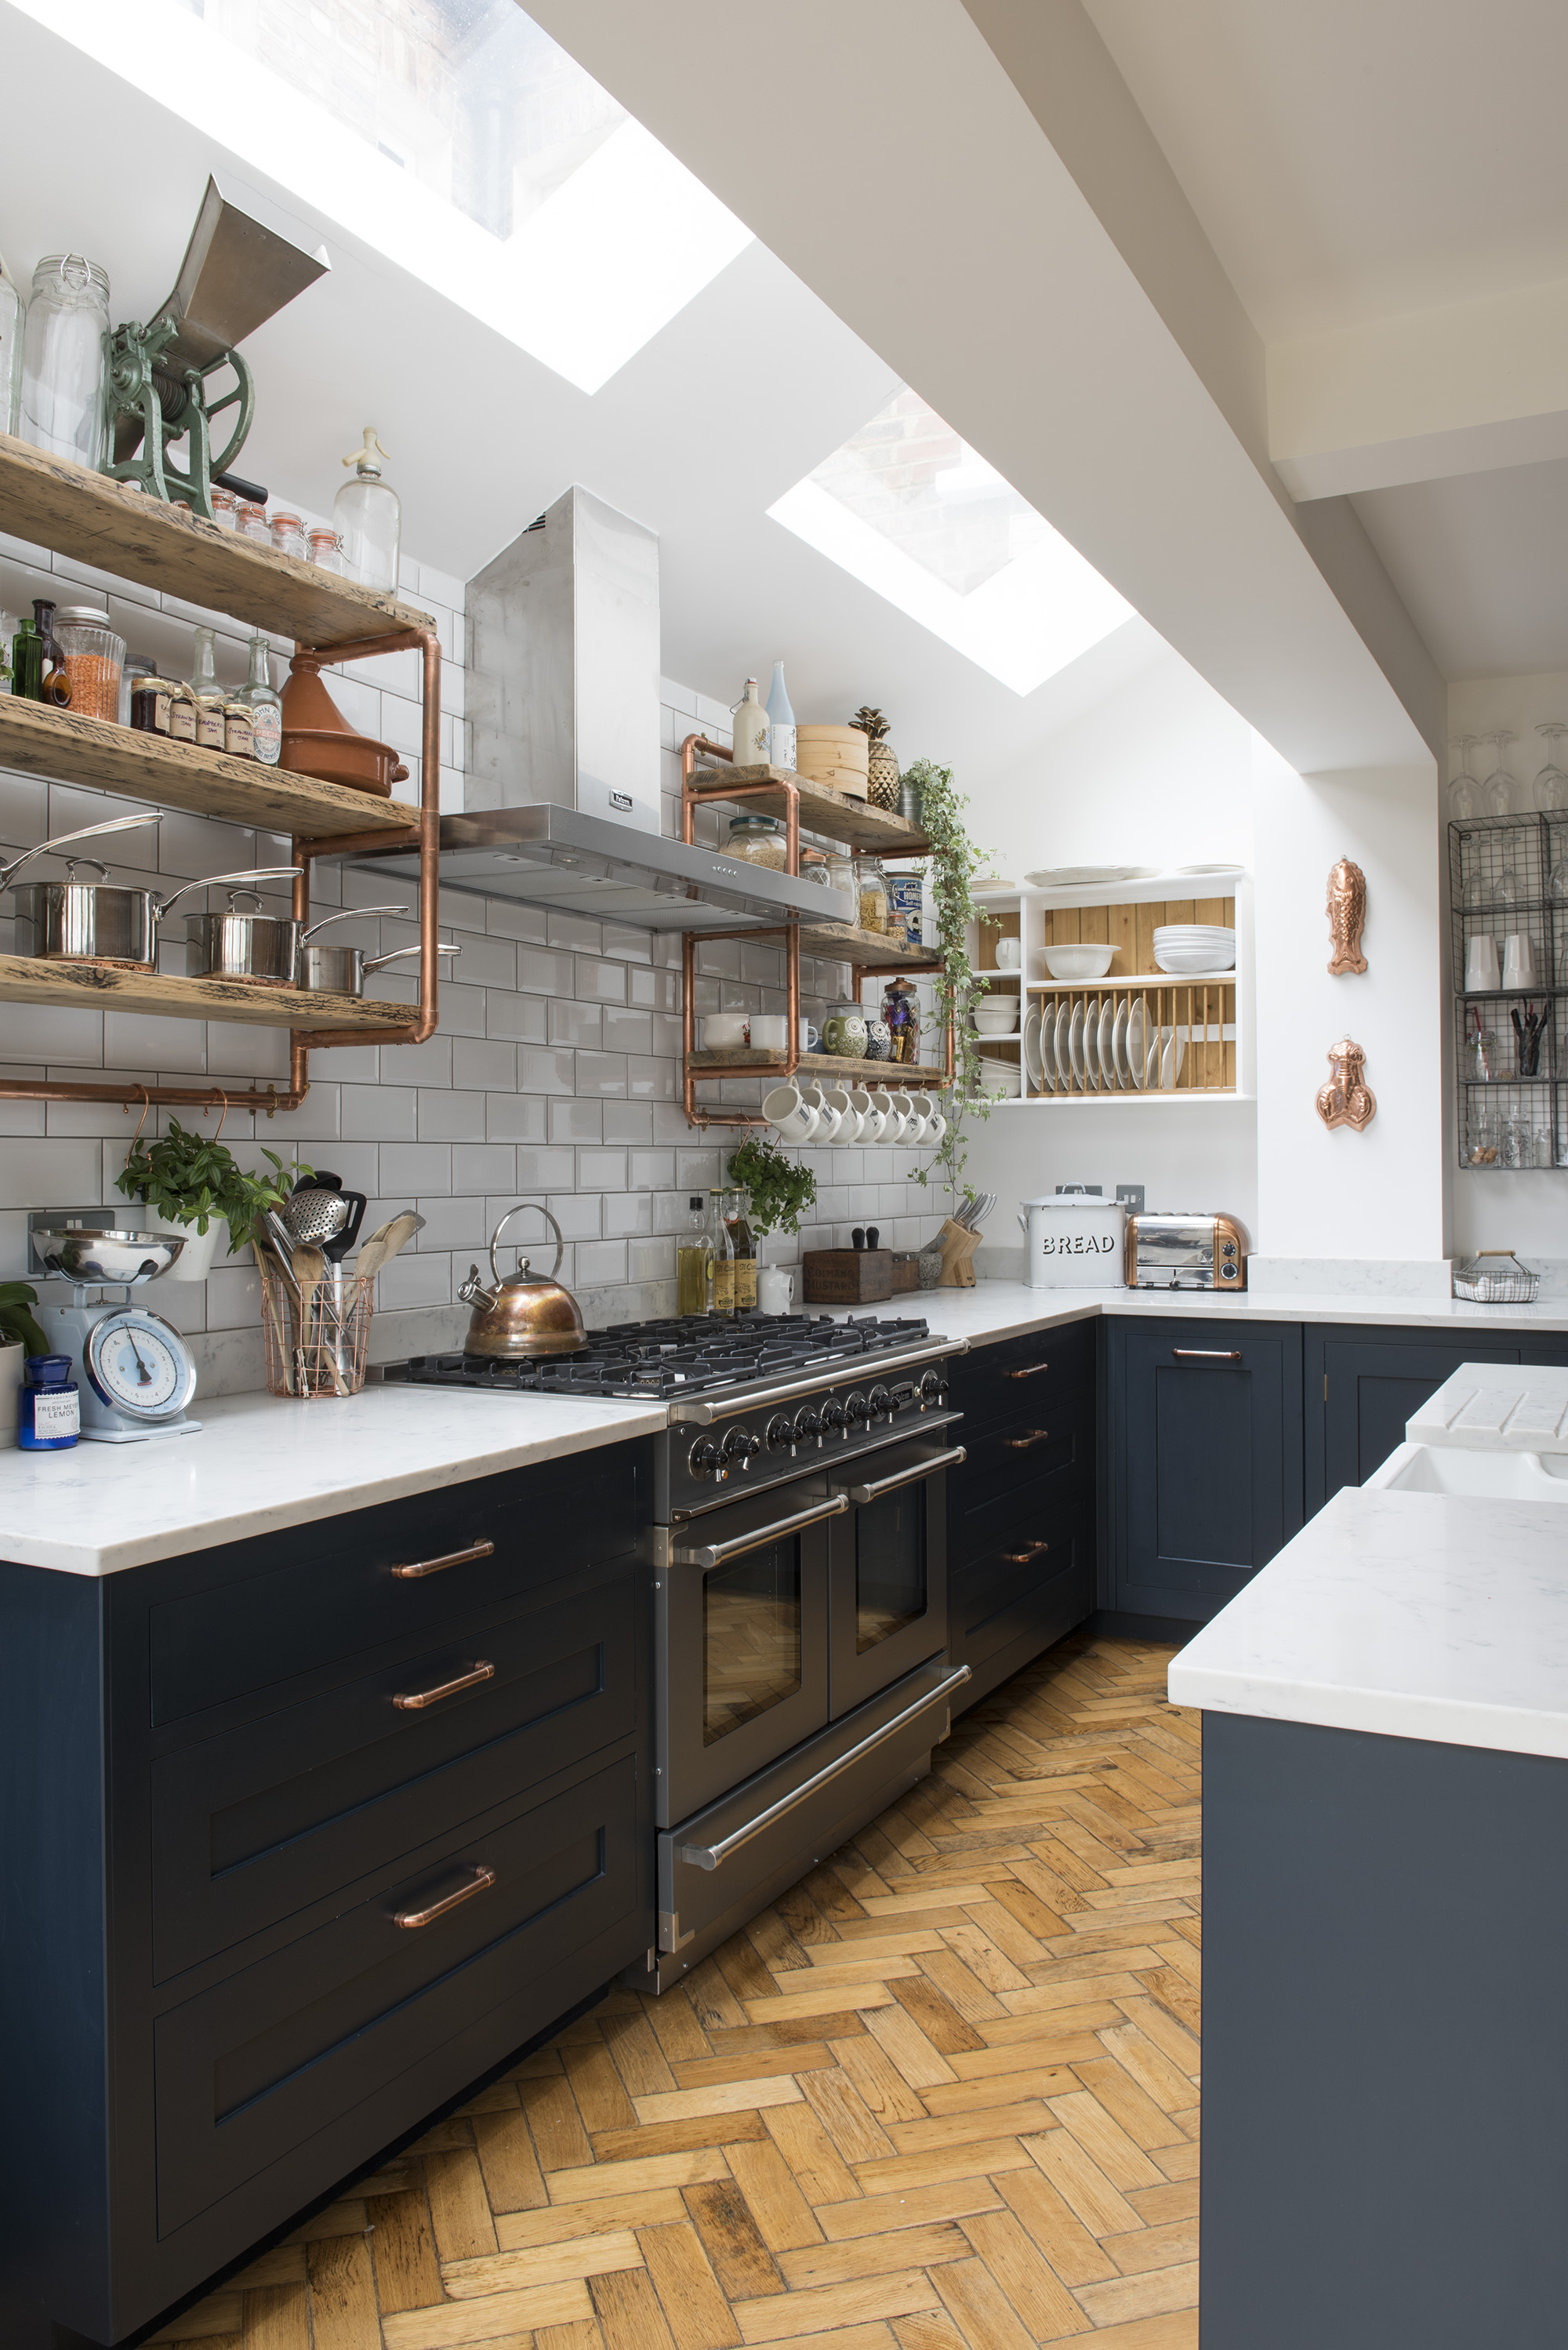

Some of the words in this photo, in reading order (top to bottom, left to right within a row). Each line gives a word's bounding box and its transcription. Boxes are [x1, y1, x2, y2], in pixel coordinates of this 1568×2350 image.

[272, 710, 281, 725] FOX
[1042, 1235, 1115, 1255] BREAD
[49, 1410, 74, 1418] LEMON
